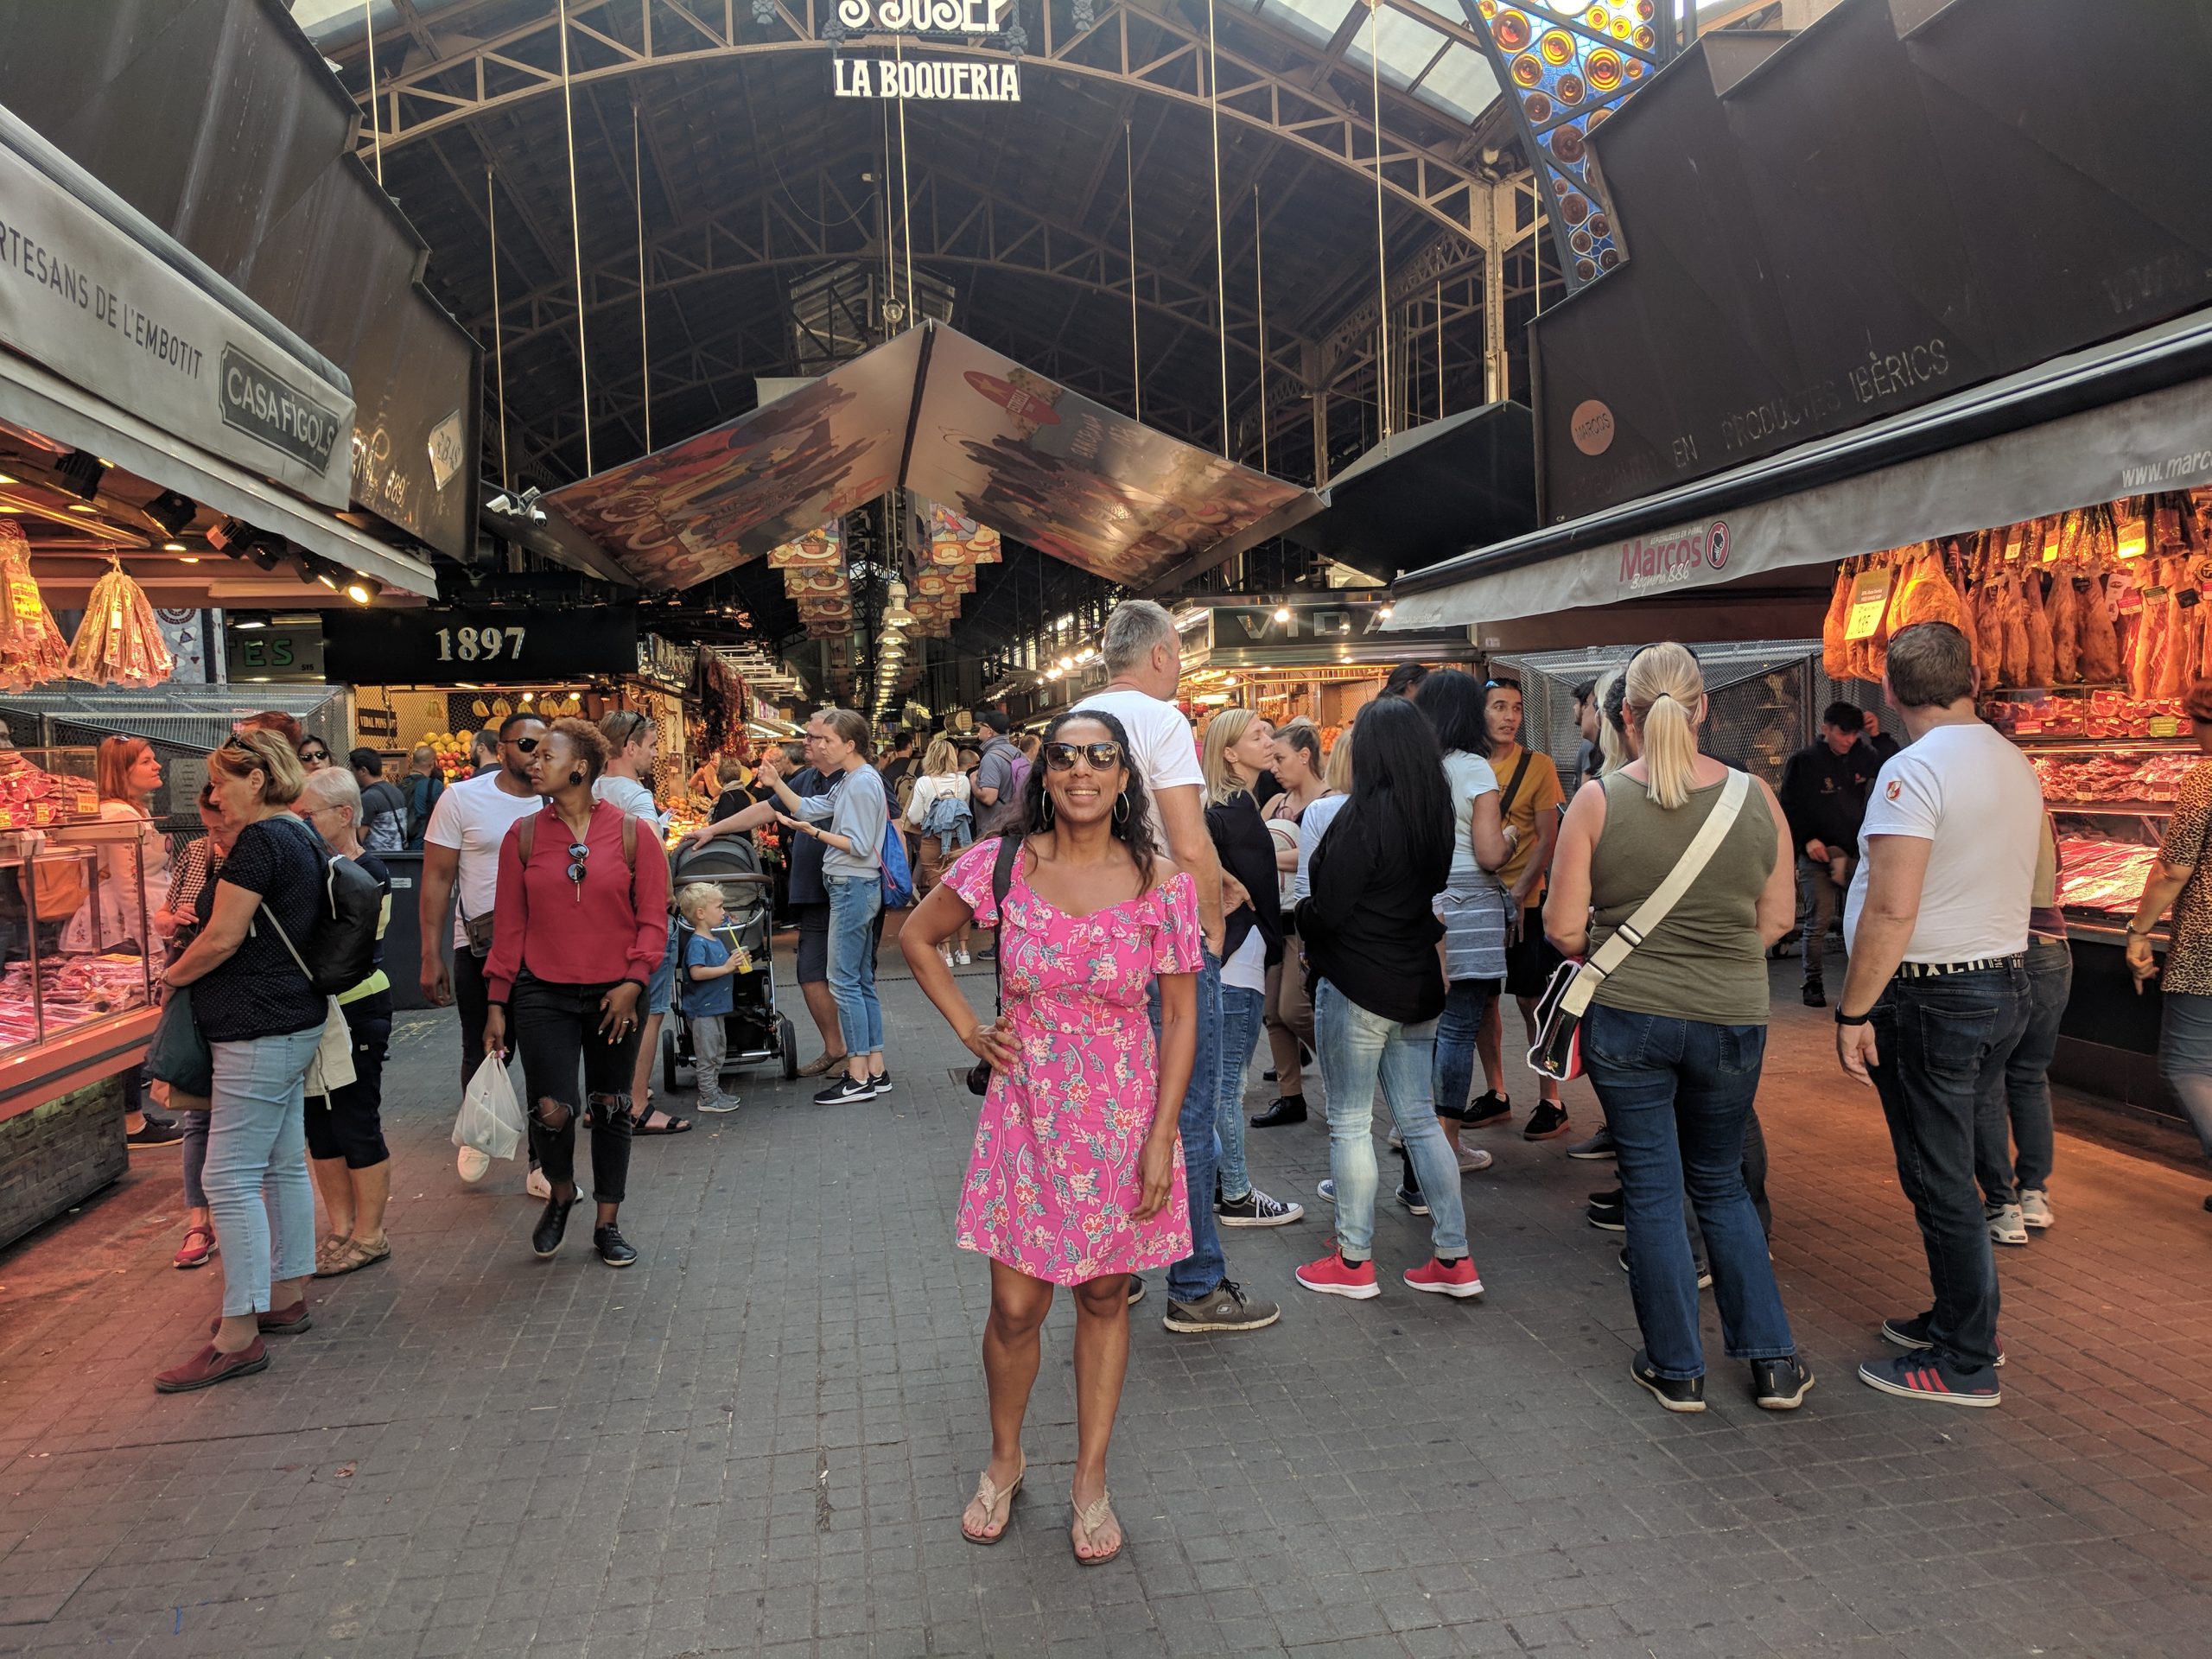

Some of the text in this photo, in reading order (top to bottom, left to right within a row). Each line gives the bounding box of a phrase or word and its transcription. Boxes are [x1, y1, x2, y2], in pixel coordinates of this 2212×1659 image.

[834, 59, 1021, 102] LA BOQUERIA
[96, 284, 118, 329] DE
[124, 303, 203, 380] L'EMBOTIT
[227, 366, 280, 429] CASA
[1574, 412, 1611, 442] MARCOS
[1671, 434, 1699, 468] EN
[1619, 536, 1702, 582] Marcos
[435, 626, 526, 662] 1897
